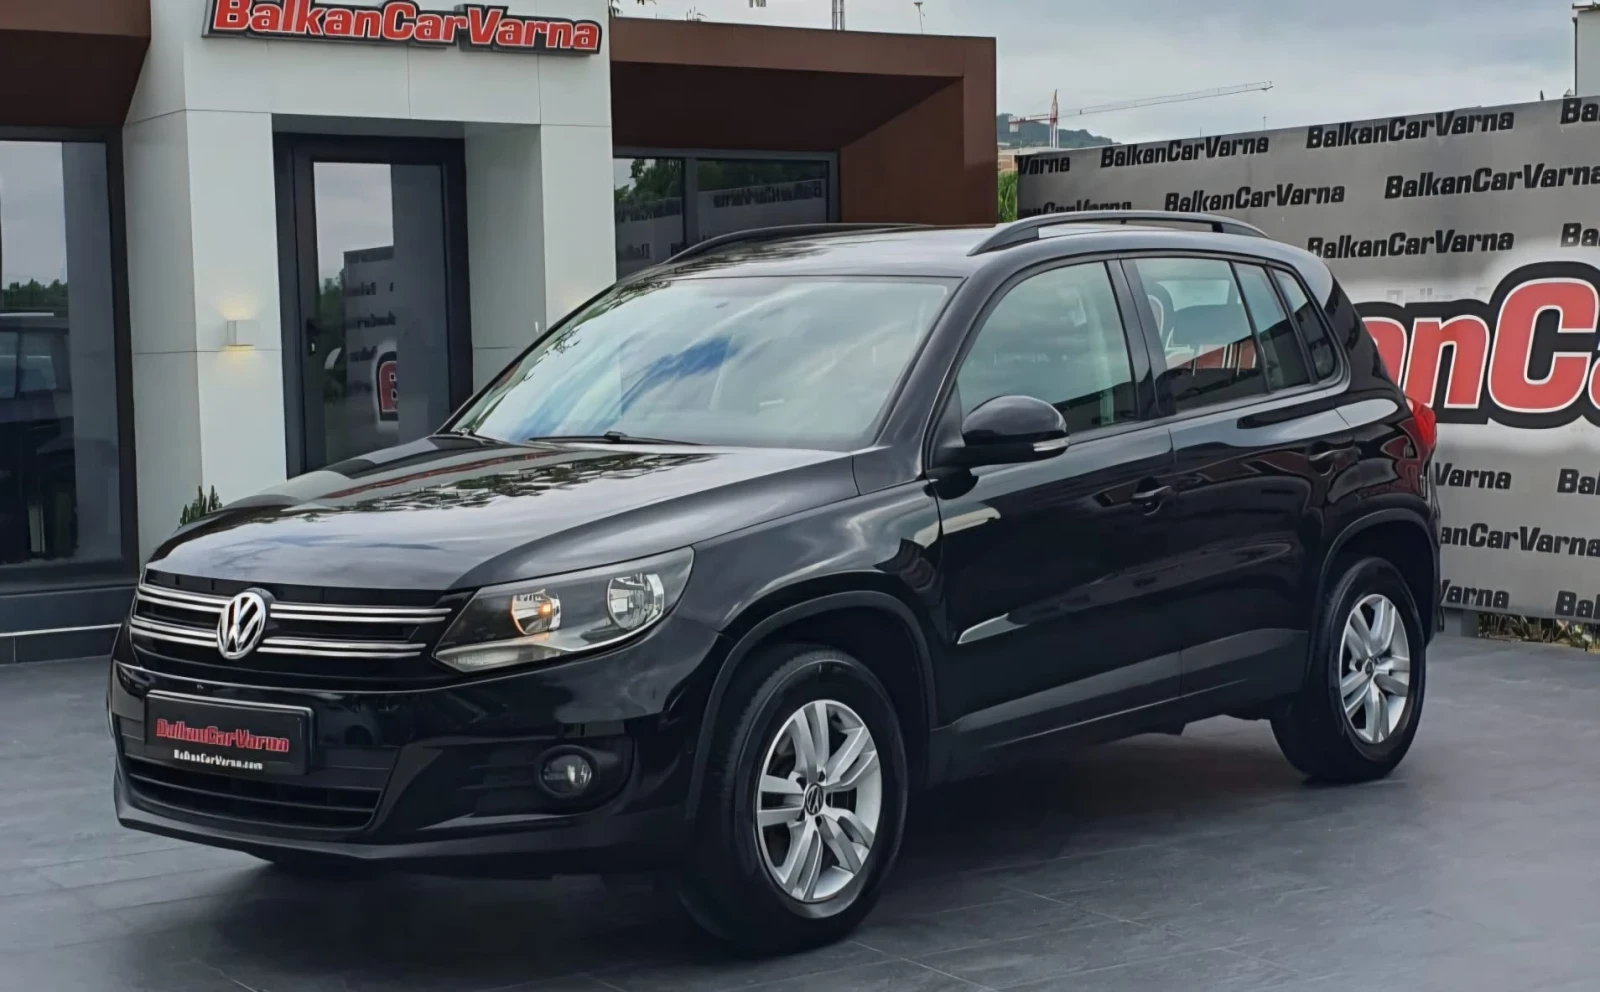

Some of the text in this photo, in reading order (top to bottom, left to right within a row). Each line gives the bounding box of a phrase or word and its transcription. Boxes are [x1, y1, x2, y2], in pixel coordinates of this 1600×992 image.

[212, 0, 599, 50] BalkanCarVarna
[1560, 98, 1600, 124] Ba
[1306, 111, 1514, 149] BalkanCarVarna
[1100, 136, 1269, 168] BalkanCarVarna
[1384, 163, 1600, 199] BalkanCarVarna
[1165, 183, 1345, 212] BalkanCarVarna
[1307, 230, 1515, 259] BalkanCarVarna
[1560, 223, 1600, 247] Ba
[1435, 462, 1512, 489] Varna
